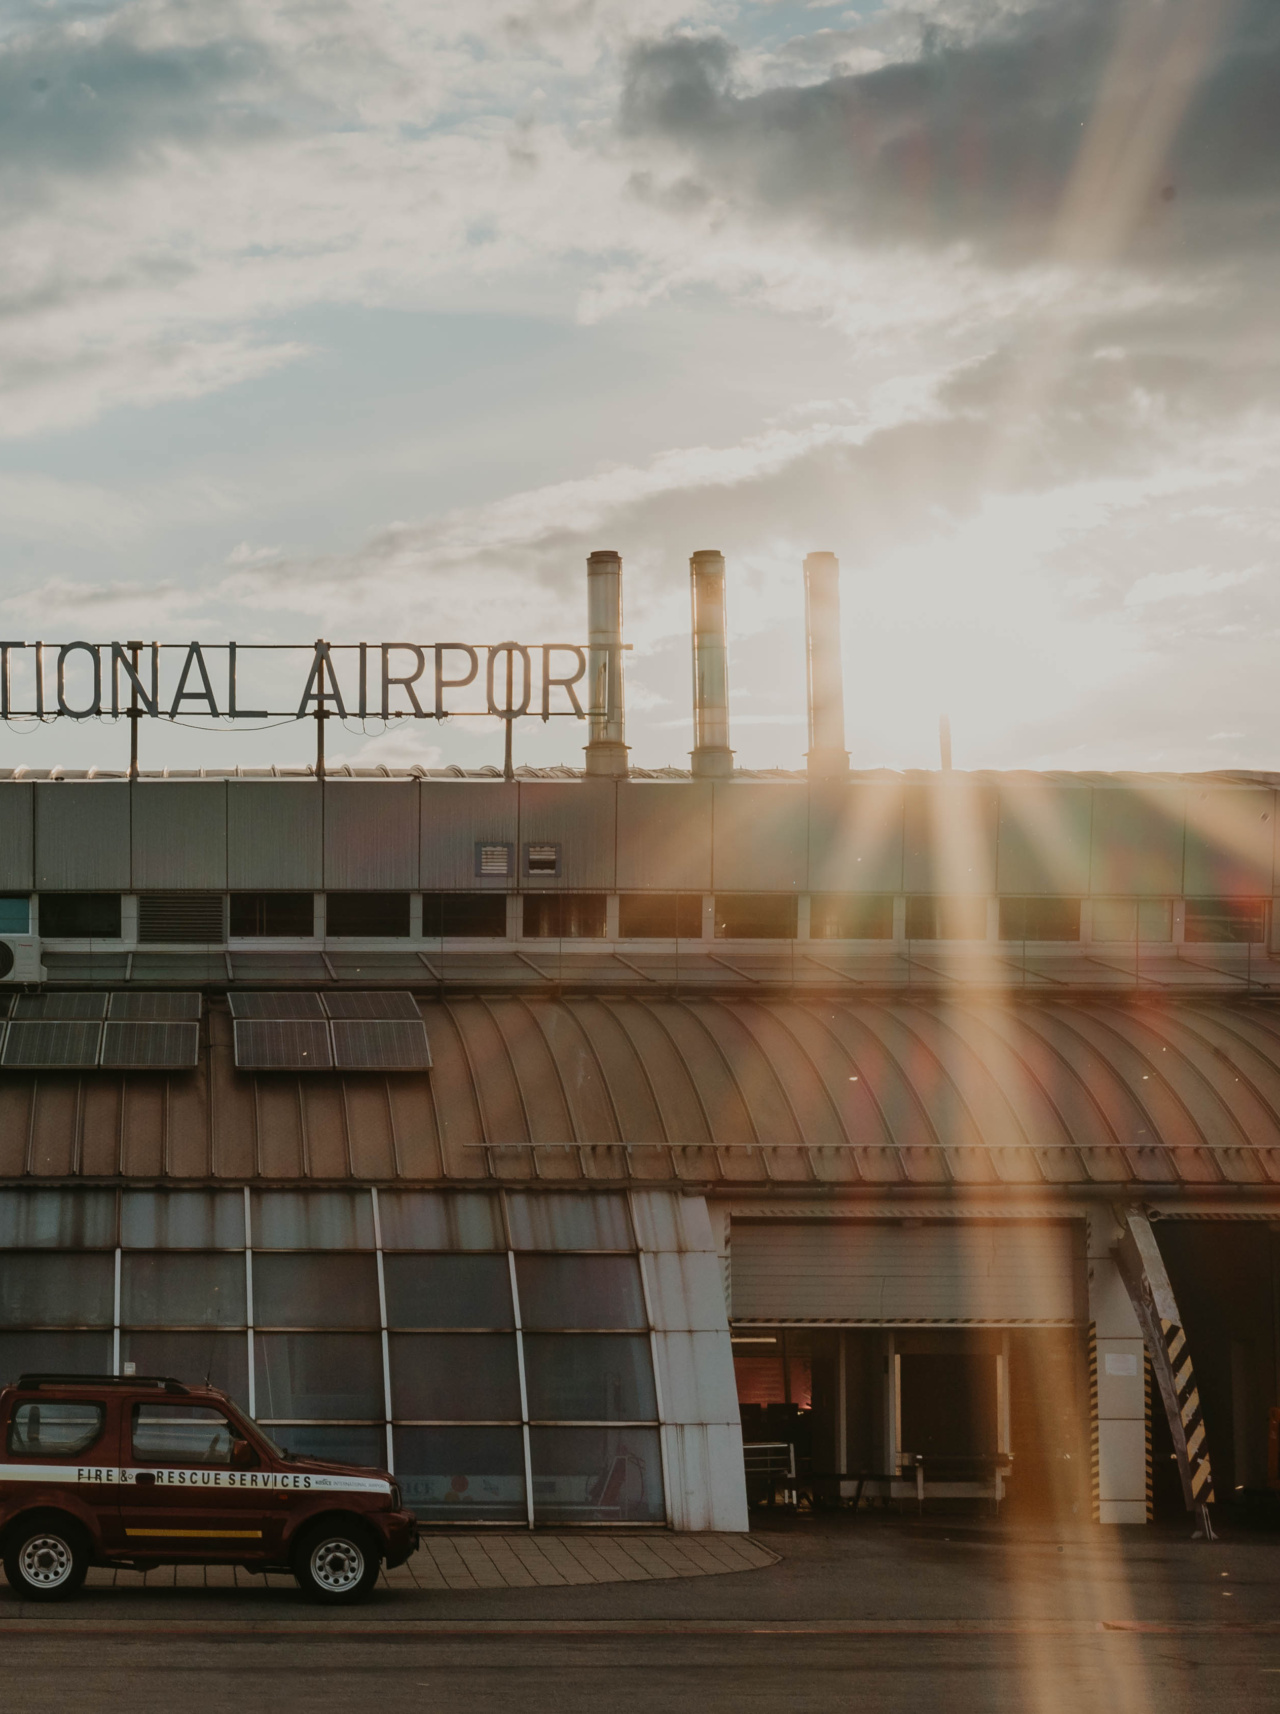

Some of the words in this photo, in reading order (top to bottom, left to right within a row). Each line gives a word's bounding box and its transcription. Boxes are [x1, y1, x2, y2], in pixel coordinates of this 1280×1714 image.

[297, 641, 633, 721] AIRPORT
[77, 1468, 114, 1482] FIRE
[120, 1470, 128, 1483] &
[156, 1471, 222, 1486] RESCUE
[228, 1473, 312, 1488] SERVICES
